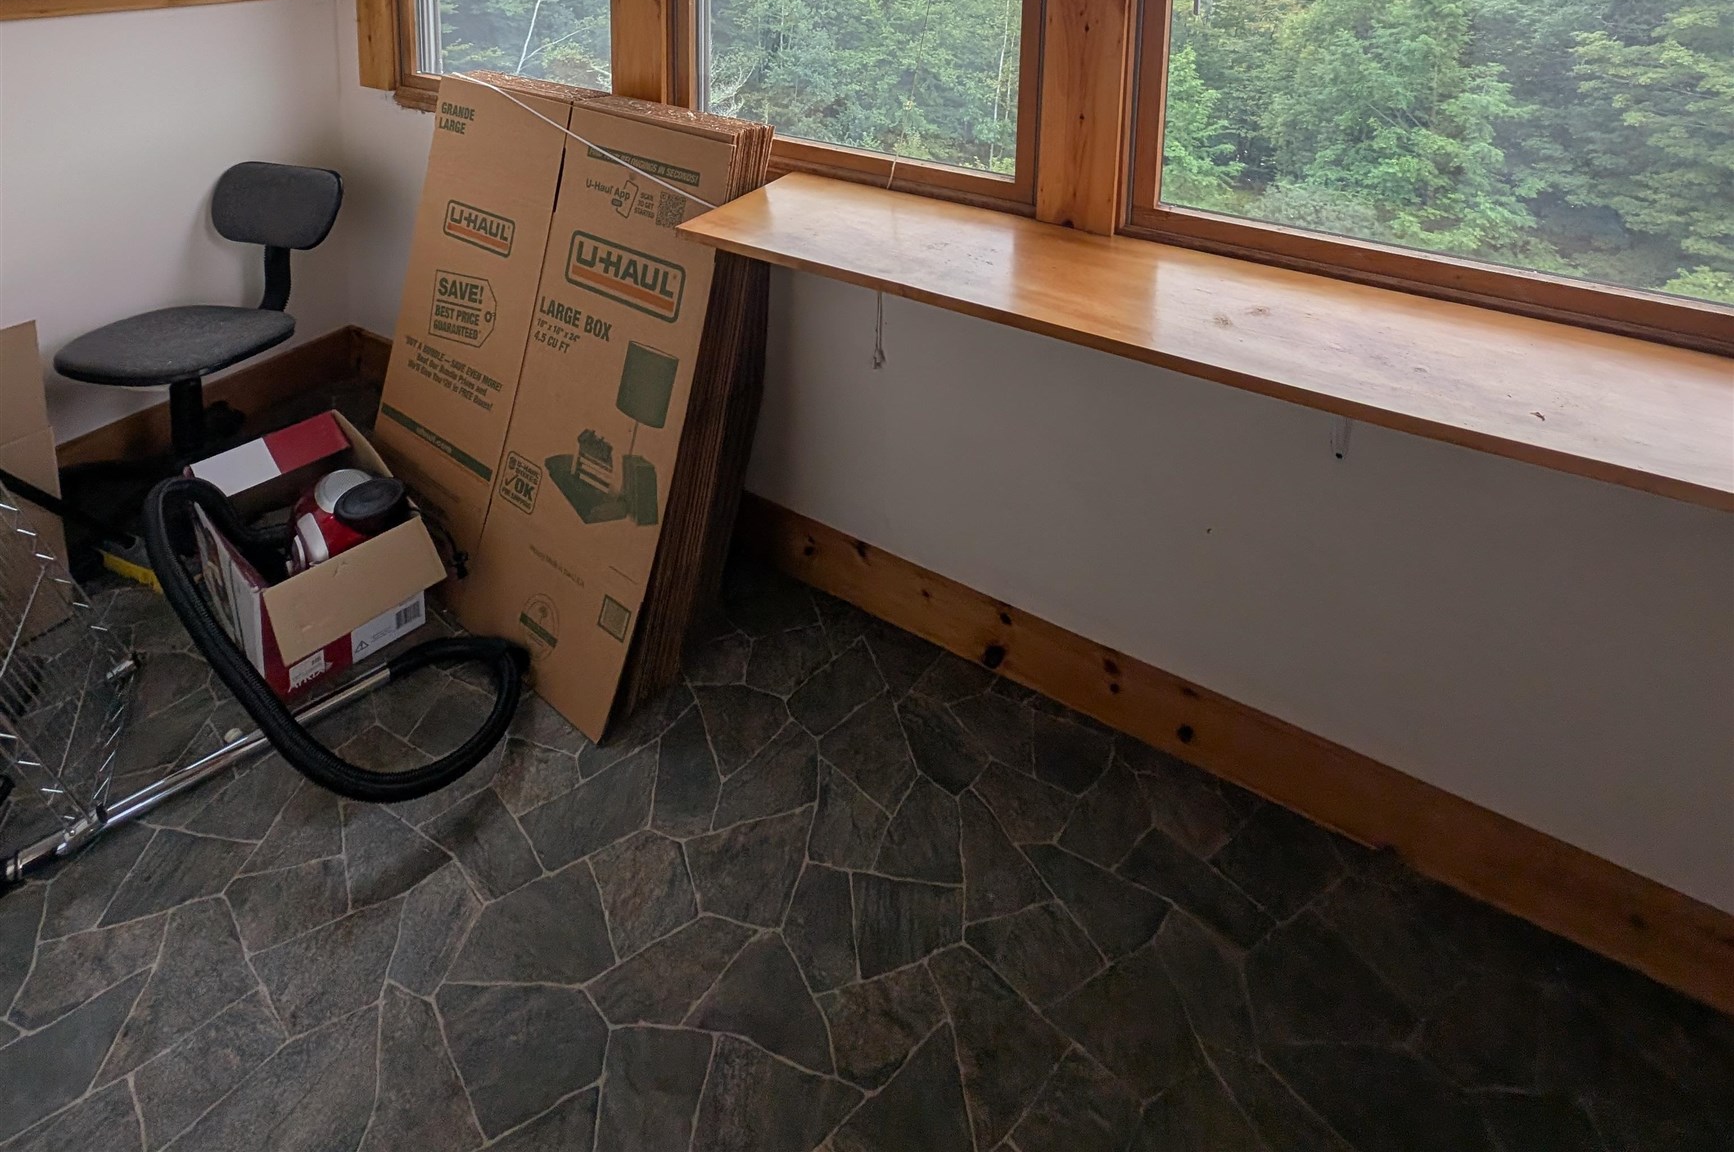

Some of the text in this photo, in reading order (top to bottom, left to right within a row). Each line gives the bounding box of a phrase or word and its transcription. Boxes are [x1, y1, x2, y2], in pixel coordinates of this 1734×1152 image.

[441, 102, 475, 121] GRANDE
[438, 117, 466, 134] LARGE
[665, 167, 699, 184] SECONDS!
[586, 178, 631, 202] U-Haul App
[449, 205, 509, 242] U-HAUL
[575, 240, 675, 299] U-HAUL
[438, 277, 484, 305] SAVE!
[434, 304, 480, 327] BEST PRICE
[539, 295, 613, 342] LARGE BOX
[433, 319, 479, 341] GUARANTEED
[534, 330, 570, 354] 4.5 CU FT
[465, 366, 482, 382] EVEN
[458, 386, 474, 401] FREE
[514, 477, 535, 502] OK
